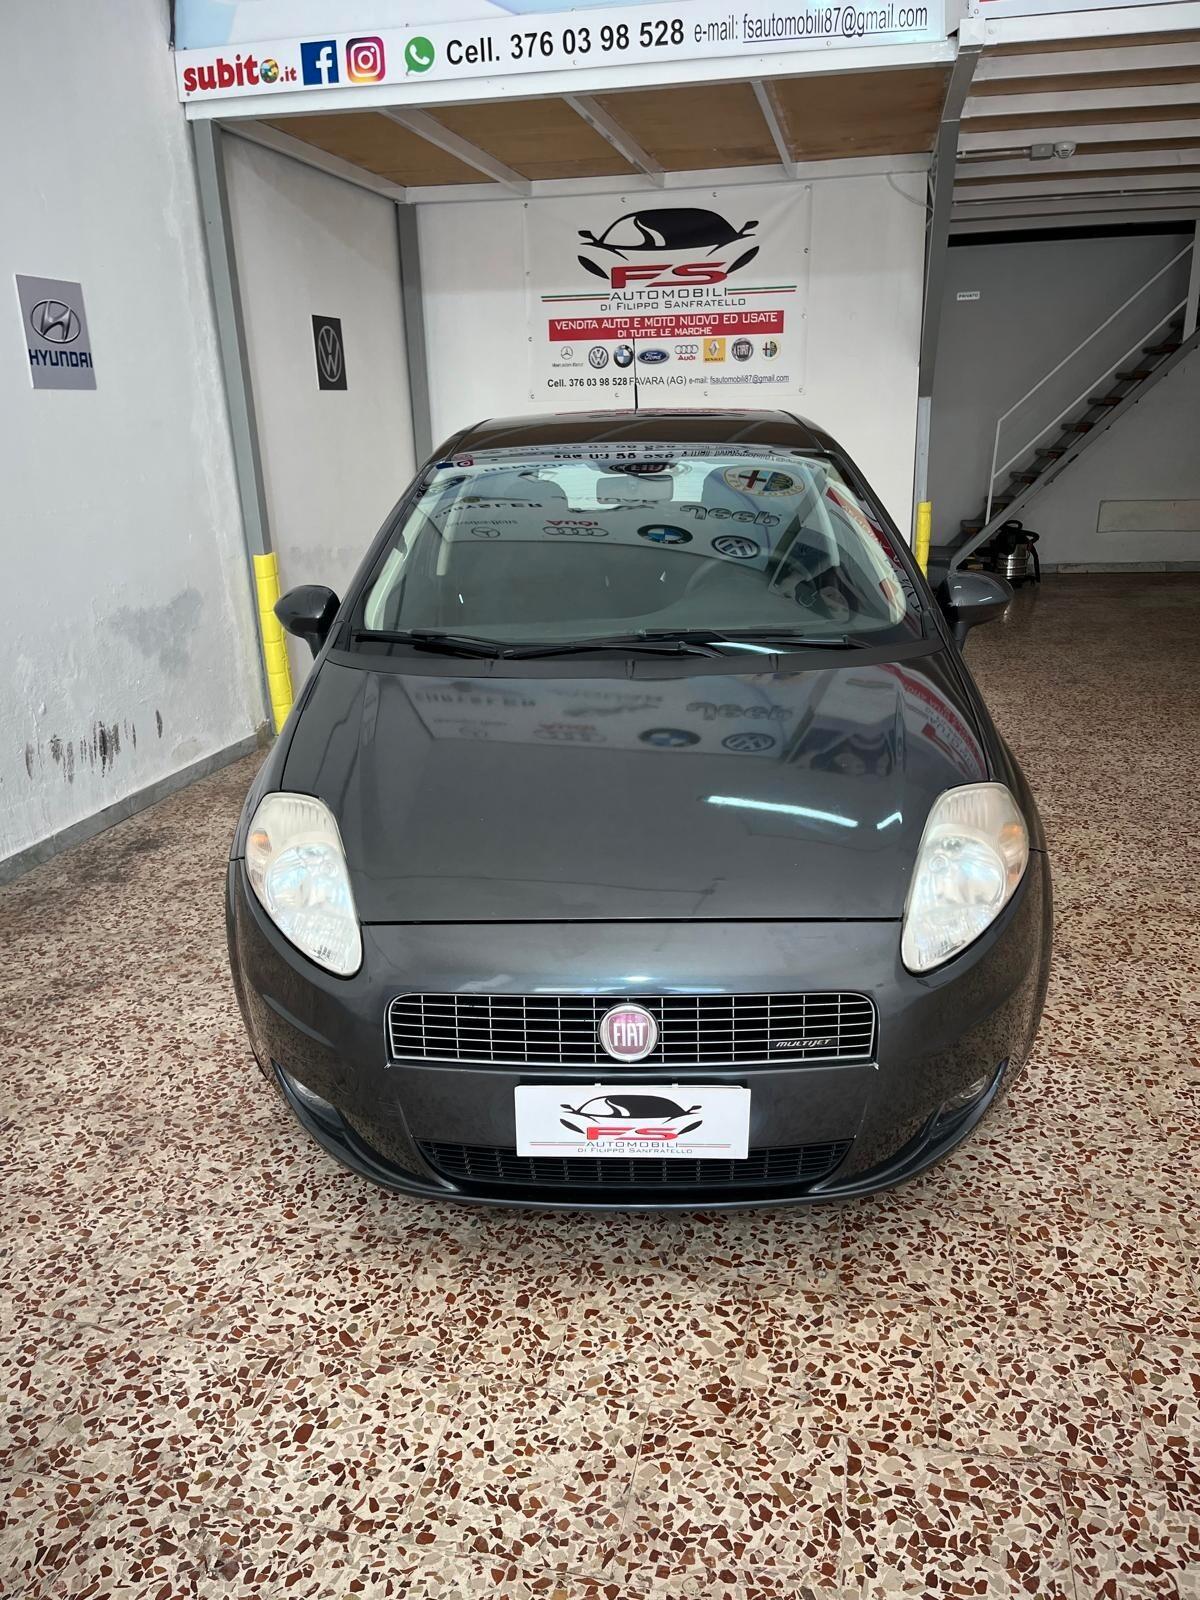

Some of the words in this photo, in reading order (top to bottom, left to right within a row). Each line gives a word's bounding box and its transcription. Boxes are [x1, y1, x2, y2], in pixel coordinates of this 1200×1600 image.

[446, 37, 500, 65] Cell.
[510, 31, 554, 60] 376
[562, 27, 592, 55] 03
[600, 23, 630, 51] 98
[639, 18, 685, 48] 528
[694, 14, 739, 42] e-mail:
[743, 4, 928, 40] fsautomobili87@gmail.com
[611, 262, 728, 289] FS
[610, 287, 727, 301] AUTOMOBILI
[600, 303, 611, 311] DI
[617, 302, 659, 311] FILIPPO
[664, 298, 746, 309] SANFRATELLO
[555, 319, 599, 330] VENDITA
[602, 318, 629, 328] AUTO
[634, 318, 641, 328] E
[644, 316, 675, 327] MOTO
[680, 314, 719, 325] NUOVO
[723, 313, 738, 324] ED
[743, 312, 778, 323] USATE
[617, 329, 627, 338] DI
[630, 329, 657, 337] TUTTE
[660, 328, 671, 336] LE
[675, 327, 713, 336] MARCHE
[28, 348, 93, 369] HYUNDAI
[547, 379, 567, 387] Cell.
[569, 378, 584, 387] 376
[586, 378, 597, 386] 03
[599, 378, 610, 386] 98
[612, 377, 628, 386] 528
[629, 376, 665, 386] FAVARA
[666, 375, 687, 387] (AG)
[612, 1022, 646, 1047] FIAT
[775, 1038, 832, 1048] MULTIJET
[586, 1126, 678, 1140] FS
